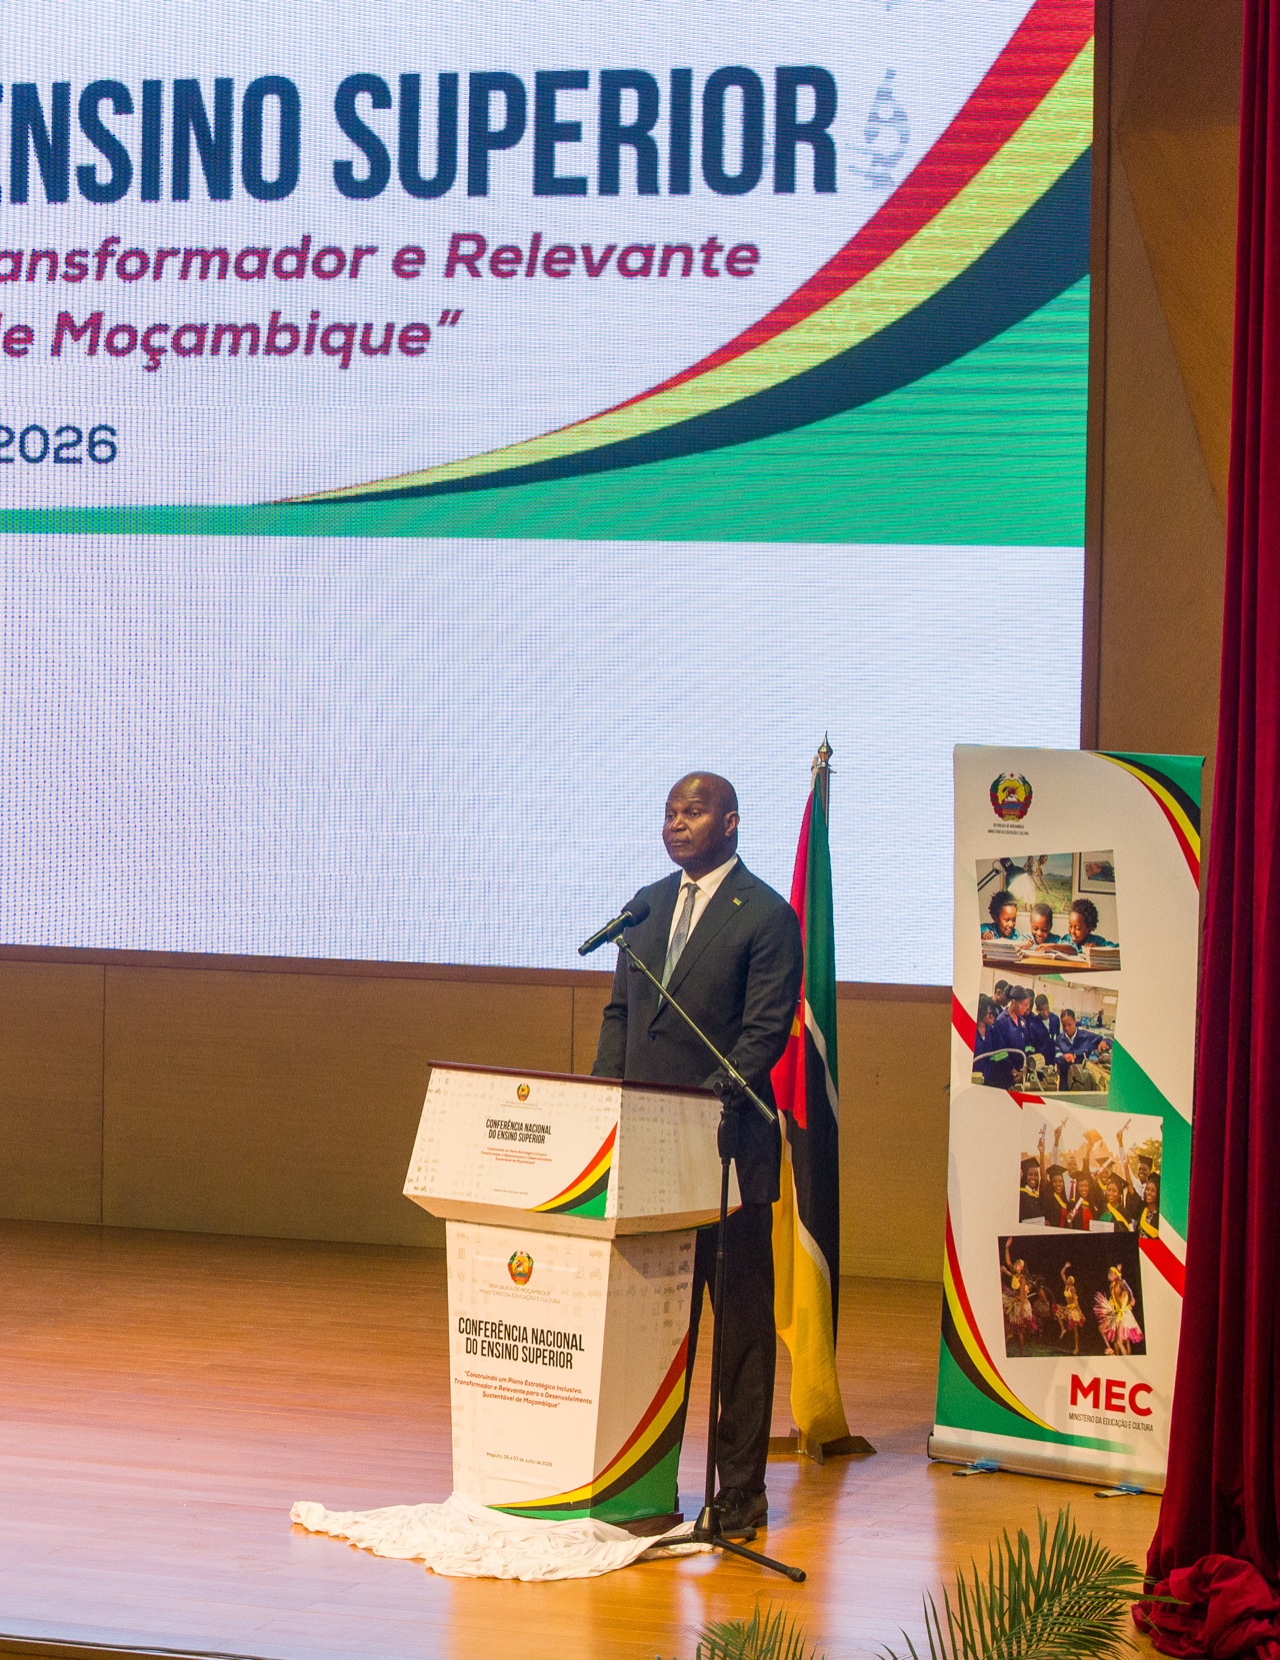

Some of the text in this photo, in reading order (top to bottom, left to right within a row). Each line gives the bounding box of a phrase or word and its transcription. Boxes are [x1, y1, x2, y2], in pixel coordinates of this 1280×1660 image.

[332, 65, 838, 201] SUPERIOR
[391, 246, 426, 280] e
[443, 231, 760, 279] Relevante
[51, 308, 463, 372] Moçambique”
[486, 1118, 552, 1135] CONFERÊNCIA NACIONAL
[488, 1129, 546, 1145] DO ENSINO SUPERIOR
[458, 1317, 585, 1352] CONFERÊNCIA NACIONAL
[465, 1337, 573, 1369] DO ENSINO SUPERIOR
[454, 1378, 493, 1390] Transformador
[498, 1385, 525, 1395] Relevante
[526, 1389, 539, 1397] para
[544, 1392, 593, 1405] Desenvolvimento
[508, 1377, 524, 1386] Plano
[1070, 1373, 1154, 1417] MEC
[1068, 1412, 1095, 1424] MINISTÉRIO
[1095, 1415, 1102, 1424] DA
[1102, 1416, 1128, 1428] EDUCAÇÃO
[1132, 1421, 1154, 1431] CULTURA
